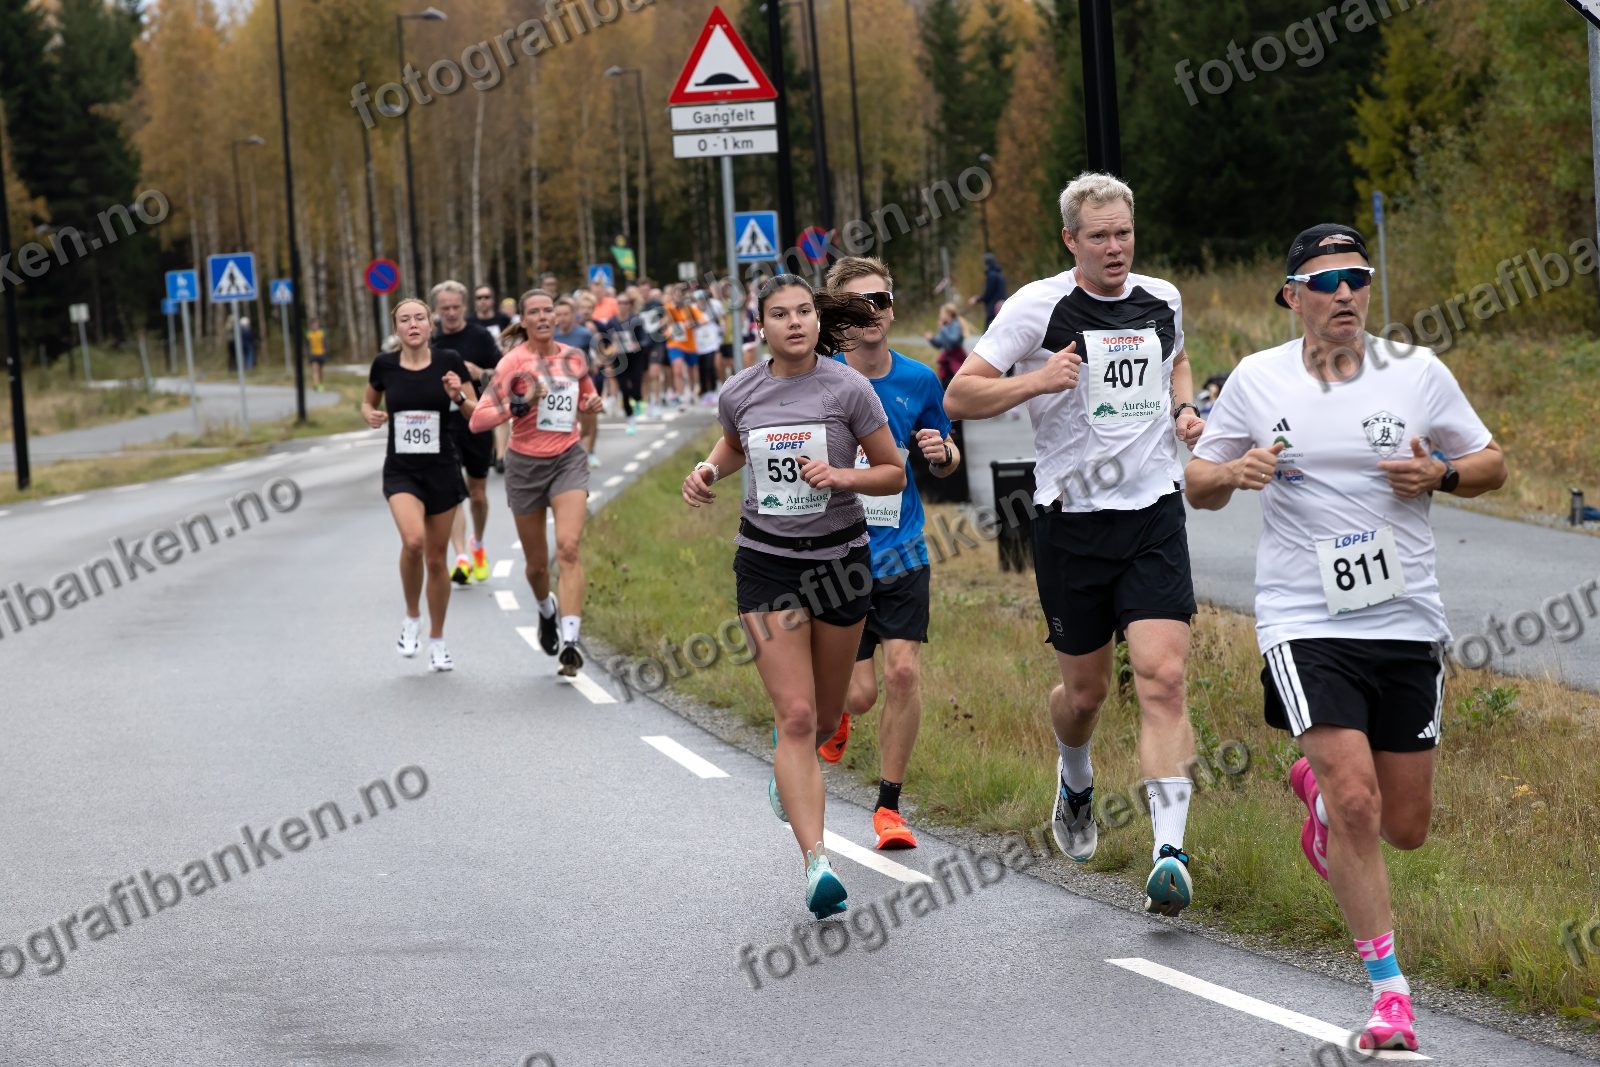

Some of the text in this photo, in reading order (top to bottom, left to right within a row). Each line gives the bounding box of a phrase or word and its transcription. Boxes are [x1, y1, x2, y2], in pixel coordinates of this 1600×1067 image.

[692, 109, 755, 125] Gangfelt
[697, 139, 707, 151] 0
[733, 136, 754, 149] km
[1102, 336, 1145, 345] NORGES
[1108, 344, 1140, 353] LØPET
[1103, 358, 1149, 388] 407
[547, 394, 572, 412] 923
[1121, 399, 1161, 412] Aurskog
[403, 428, 431, 444] 496
[766, 431, 812, 443] NORGES
[769, 441, 805, 451] LØPET
[786, 492, 829, 505] Aurskog
[865, 506, 898, 519] Aurskog
[1334, 530, 1376, 549] LØPET
[1333, 548, 1389, 591] 811
